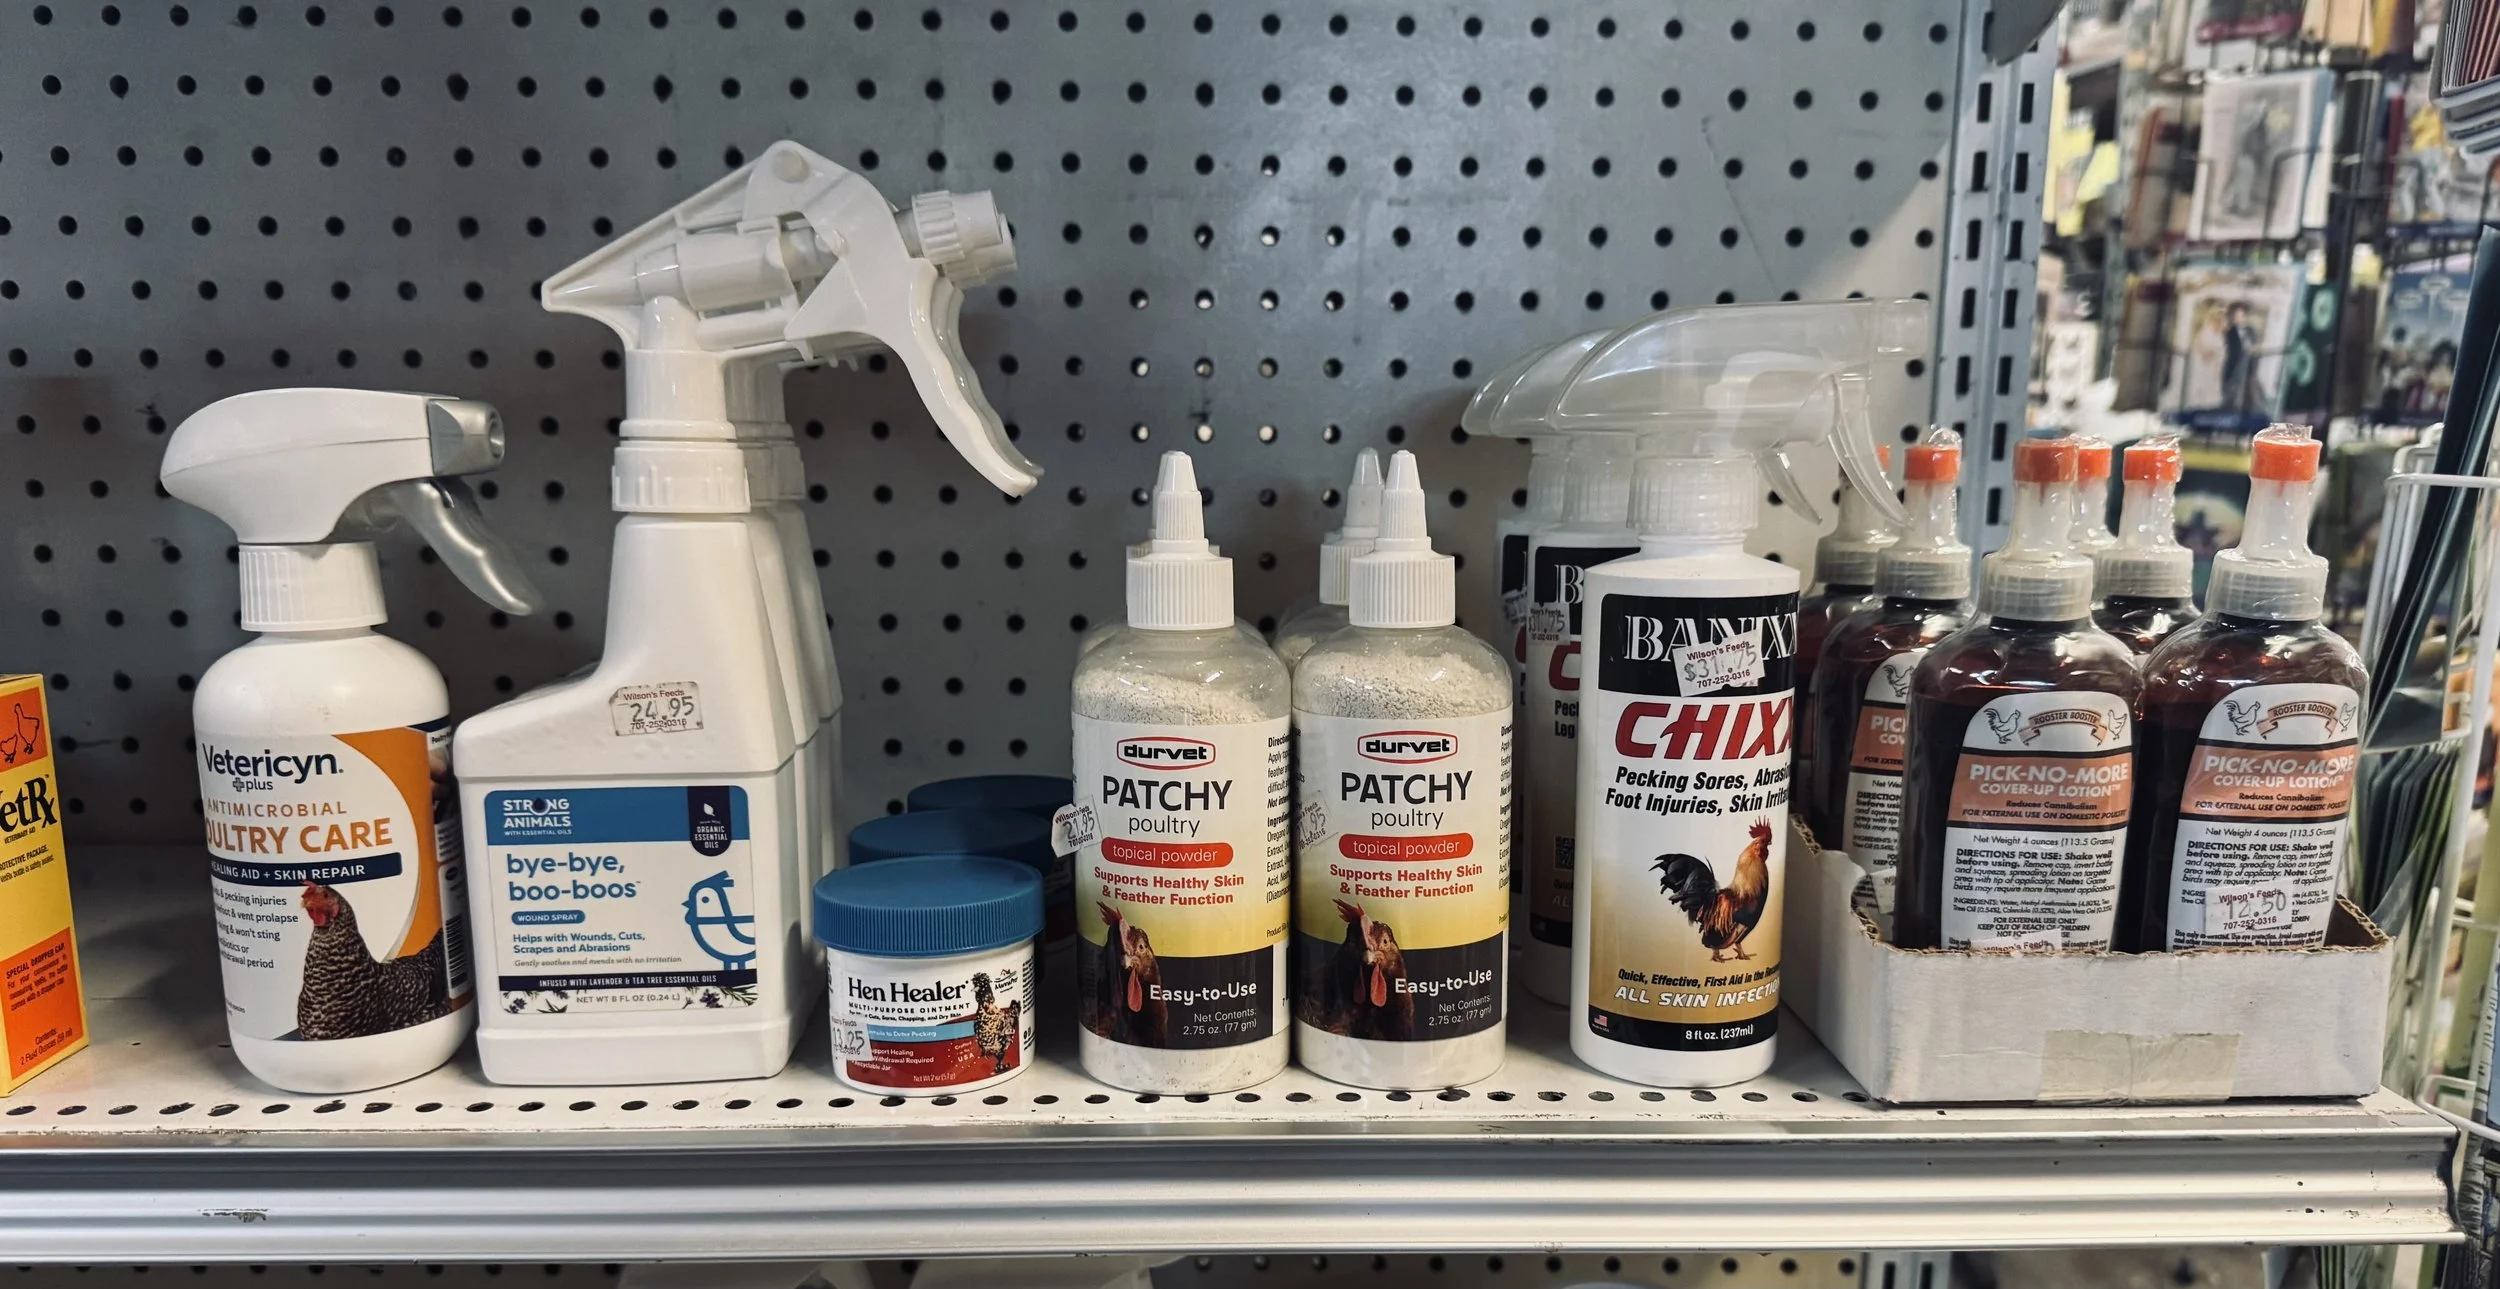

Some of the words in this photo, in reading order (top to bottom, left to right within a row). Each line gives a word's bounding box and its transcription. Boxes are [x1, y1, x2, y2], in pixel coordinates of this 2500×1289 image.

[1687, 647, 1724, 660] Wilson's
[1726, 640, 1750, 653] Feeds
[1684, 645, 1757, 682] $31.75
[1697, 669, 1751, 688] 707-252-0316
[623, 691, 658, 701] Wilson's
[660, 689, 685, 698] Feeds
[630, 696, 695, 722] 24.95
[2273, 704, 2306, 717] ROOSTER
[2034, 711, 2068, 725] ROOSTER
[1554, 720, 1575, 739] Leg
[1124, 744, 1207, 760] durvet
[1366, 738, 1450, 754] durvet
[2204, 755, 2355, 775] PICK-NO-MORE
[1615, 766, 1689, 793] Pecking
[1693, 771, 1749, 791] Sores,
[1970, 762, 2128, 784] PICK-NO-MORE
[246, 778, 273, 792] plus
[1341, 770, 1473, 805] PATCHY
[2213, 774, 2285, 788] COVER-UP
[1103, 775, 1233, 811] PATCHY
[1980, 783, 2055, 796] COVER-UP
[0, 776, 57, 832] etRx
[208, 797, 347, 818] ANTIMICROBIAL
[503, 798, 570, 815] STRONG
[1605, 787, 1642, 809] Foot
[1646, 793, 1723, 817] Injuries,
[1729, 793, 1763, 813] Skin
[1856, 799, 1885, 808] before
[504, 816, 572, 828] ANIMALS
[1371, 808, 1444, 830] poultry
[2059, 811, 2100, 820] DOMESTIC
[1129, 815, 1200, 838] poultry
[2206, 828, 2222, 836] Net
[2223, 828, 2252, 838] Weight
[205, 817, 289, 853] OULTRY
[300, 818, 393, 853] CARE
[694, 833, 728, 841] ESSENTIAL
[1973, 835, 1989, 843] Net
[1991, 835, 2020, 846] Weight
[1353, 840, 1401, 857] topical
[1405, 839, 1460, 858] powder
[2188, 841, 2247, 851] DIRECTIONS
[2248, 843, 2267, 851] FOR
[2292, 843, 2317, 851] Shake
[1113, 845, 1156, 861] topical
[1161, 848, 1218, 864] powder
[1955, 857, 1989, 866] before
[1956, 848, 2016, 859] DIRECTIONS
[2018, 851, 2038, 860] FOR
[2064, 851, 2093, 860] Shake
[2186, 849, 2219, 859] before
[241, 868, 260, 880] AID
[275, 869, 307, 881] SKIN
[312, 864, 366, 880] REPAIR
[507, 852, 625, 878] bye-bye,
[1330, 864, 1393, 882] Supports
[1397, 868, 1452, 882] Healthy
[1457, 863, 1483, 878] Skin
[1094, 866, 1148, 887] Supports
[1153, 876, 1209, 891] Healthy
[1214, 874, 1245, 888] Skin
[1102, 885, 1111, 898] &
[1115, 888, 1165, 905] Feather
[1170, 893, 1233, 906] Function
[1340, 882, 1351, 894] &
[1355, 884, 1410, 899] Feather
[1414, 882, 1474, 898] Function
[225, 892, 251, 906] pecking
[252, 895, 287, 907] injuries
[238, 911, 255, 921] vent
[256, 913, 298, 925] prolapse
[518, 914, 549, 922] WOUND
[552, 913, 578, 921] SPRAY
[2223, 916, 2277, 930] 707-252-0316
[236, 928, 256, 939] won't
[257, 930, 281, 942] sting
[513, 934, 542, 944] Helps
[544, 933, 567, 942] with
[570, 932, 616, 942] Wounds,
[619, 931, 645, 941] Cuts,
[241, 946, 250, 954] or
[513, 945, 554, 955] Scrapes
[557, 944, 576, 953] and
[578, 943, 631, 953] Abrasions
[247, 958, 274, 969] period
[514, 959, 540, 968] Gently
[616, 956, 633, 964] with
[6, 962, 30, 979] SPECIAL
[1618, 968, 1648, 985] Quick,
[1651, 974, 1701, 988] Effective,
[1704, 976, 1726, 987] First
[1729, 974, 1743, 985] Aid
[539, 979, 567, 987] INFUSED
[589, 977, 622, 986] LAVENDER
[647, 976, 662, 984] TREE
[665, 976, 700, 984] ESSENTIAL
[702, 975, 717, 983] OILS
[1395, 969, 1492, 997] Easy-to-Use
[848, 976, 886, 1002] Hen
[890, 980, 967, 1003] Healer
[1150, 981, 1257, 1006] Easy-to-Use
[1615, 985, 1650, 1004] ALL
[1658, 993, 1709, 1008] SKIN
[849, 1002, 915, 1014] MULTI-PURPOSE
[919, 1002, 971, 1013] OINTMENT
[1194, 1013, 1212, 1023] Net
[1214, 1008, 1257, 1022] Contents:
[1439, 1003, 1455, 1013] Net
[1183, 1026, 1205, 1036] 2.75
[1207, 1026, 1221, 1034] oz.
[1224, 1022, 1238, 1034] (77
[1240, 1019, 1257, 1032] gm)
[1429, 1016, 1449, 1026] 2.75
[1685, 1030, 1692, 1040] 8
[1721, 1024, 1753, 1040] (237ml)
[891, 1049, 914, 1057] Healing
[906, 1056, 934, 1064] Required
[957, 1052, 975, 1062] USA
[854, 1061, 881, 1071] Recyclable
